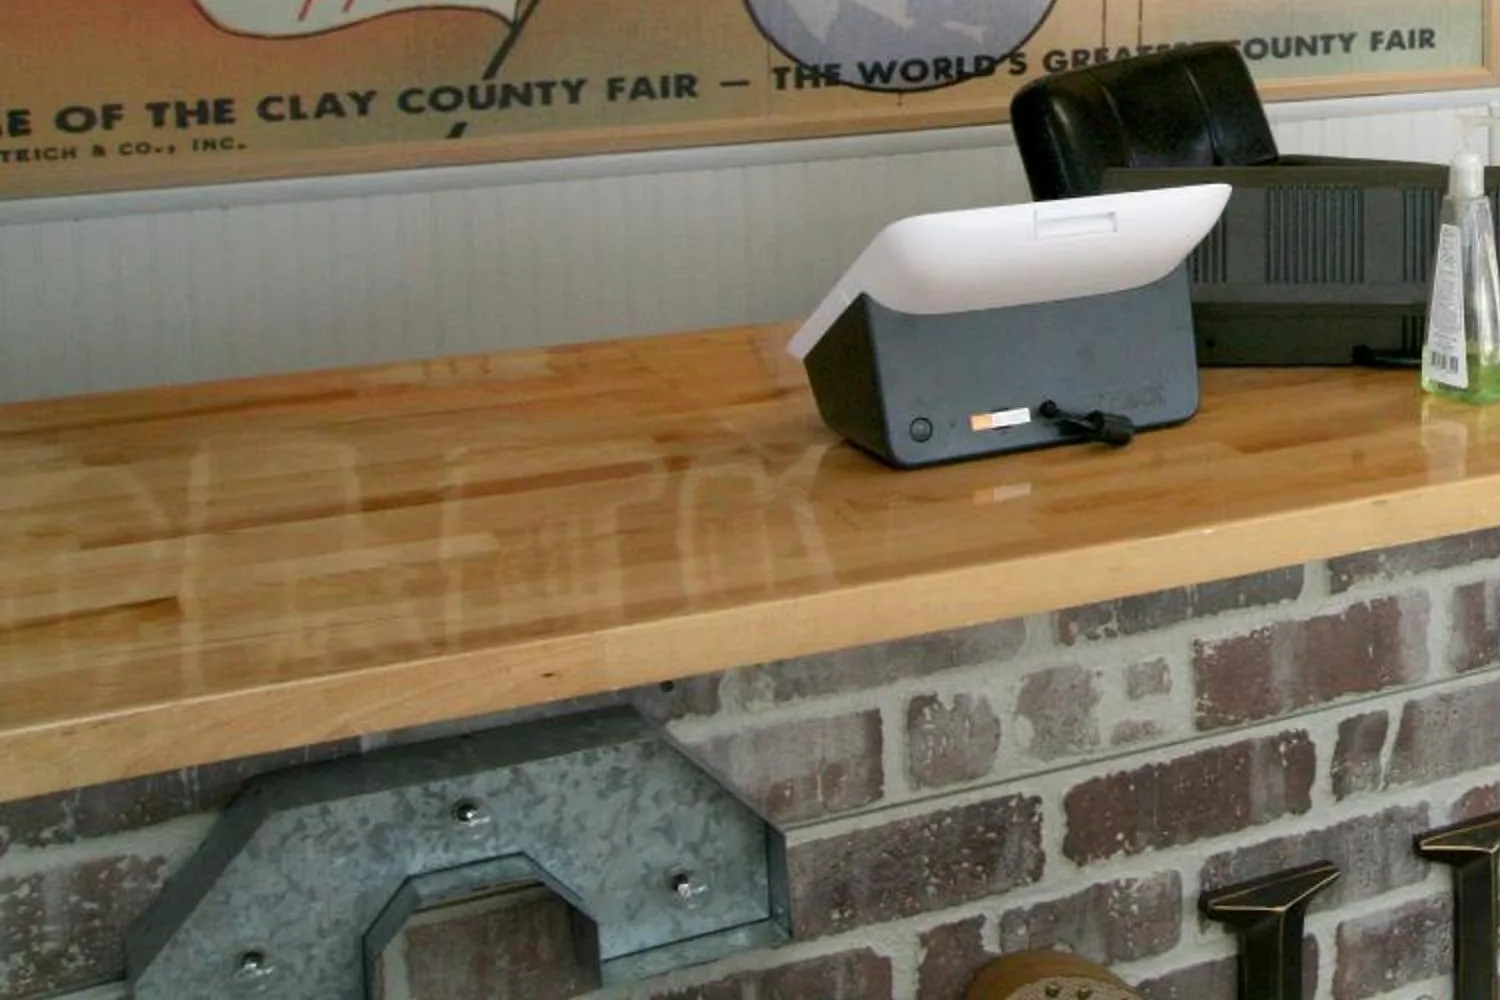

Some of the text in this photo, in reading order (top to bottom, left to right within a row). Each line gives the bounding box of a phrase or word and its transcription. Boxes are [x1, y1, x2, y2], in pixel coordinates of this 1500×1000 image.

[55, 104, 124, 134] OF
[146, 98, 236, 129] THE
[257, 90, 377, 123] CLAY
[397, 77, 588, 114] COUNTY
[606, 73, 698, 103] FAIR
[772, 61, 842, 91] THE
[857, 52, 1028, 86] WORLD'S
[1234, 31, 1358, 61] OUNTY
[1368, 27, 1437, 54] FAIR
[192, 137, 248, 153] INC.
